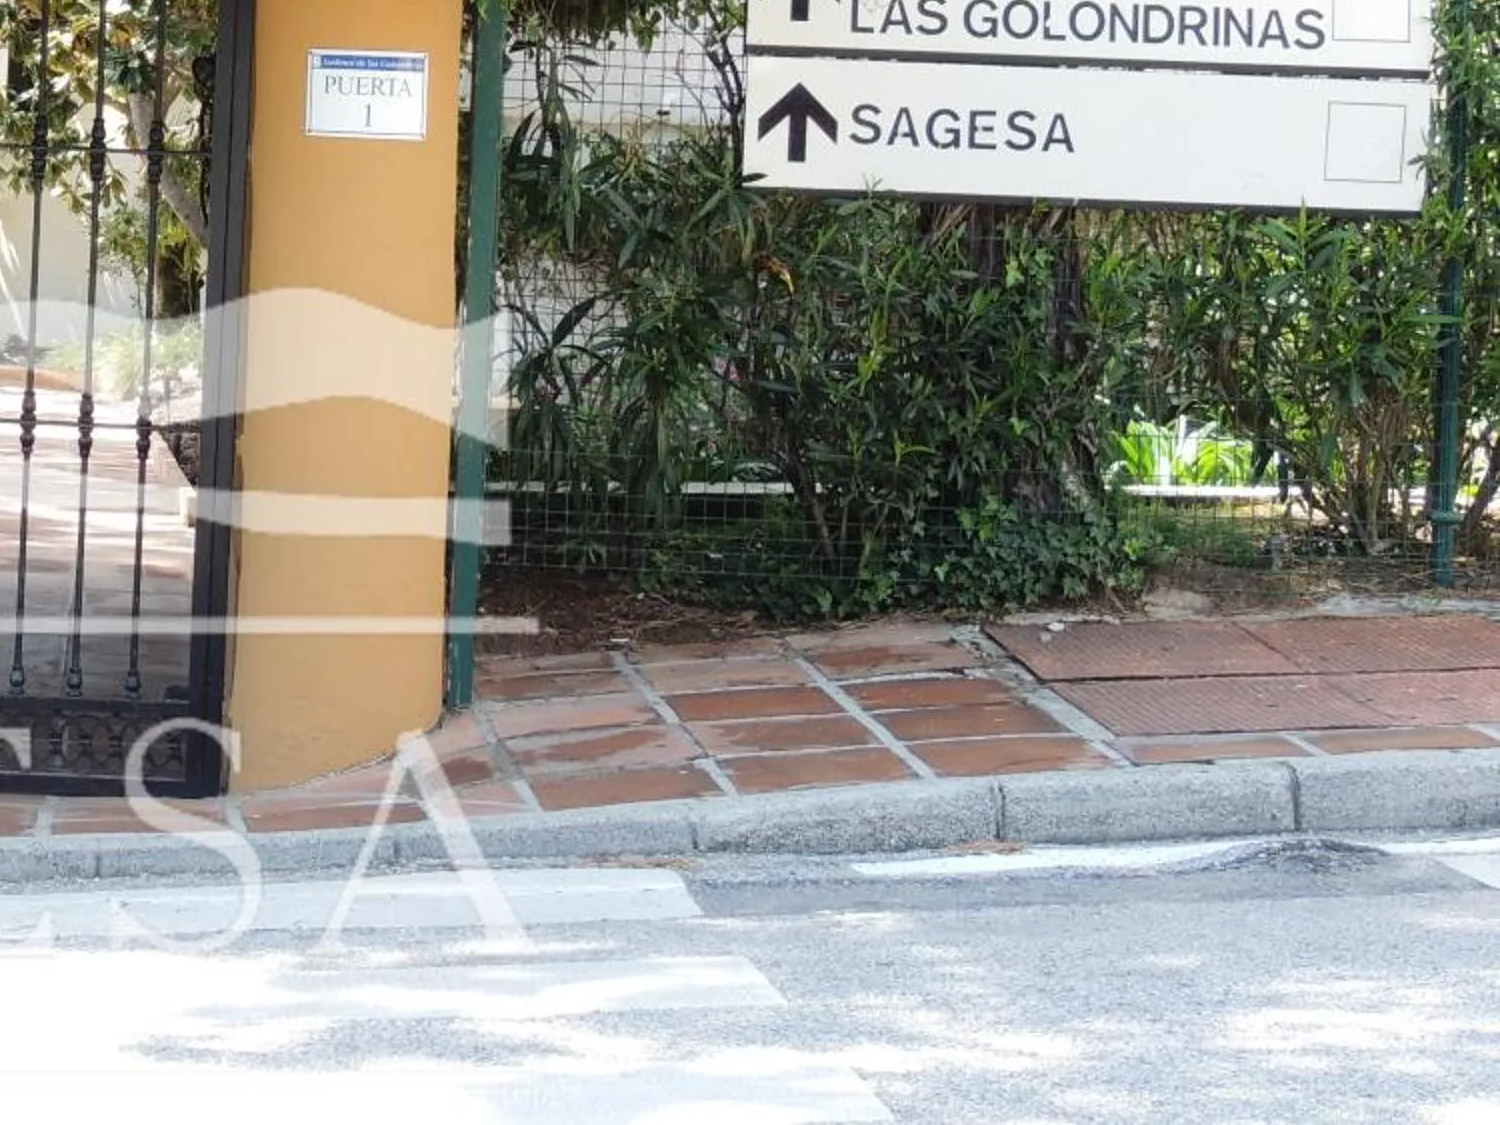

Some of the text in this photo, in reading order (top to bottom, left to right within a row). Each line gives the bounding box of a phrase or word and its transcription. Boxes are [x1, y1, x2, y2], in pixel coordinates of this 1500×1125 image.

[323, 75, 412, 97] PUERTA
[364, 103, 372, 127] 1
[849, 105, 1074, 154] SAGESA
